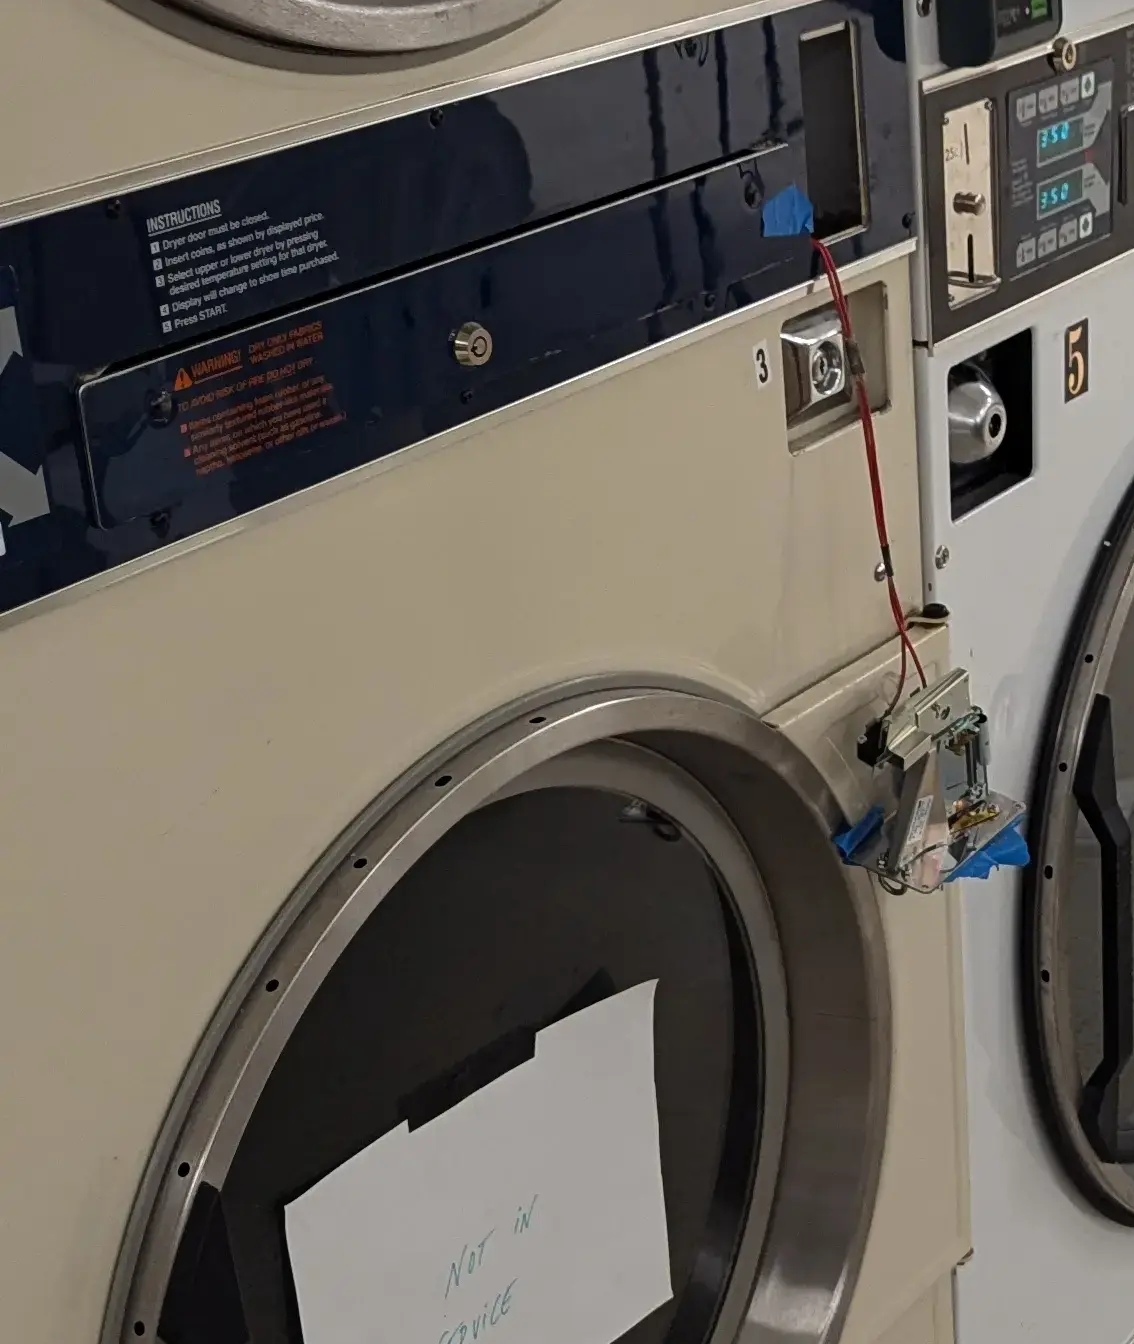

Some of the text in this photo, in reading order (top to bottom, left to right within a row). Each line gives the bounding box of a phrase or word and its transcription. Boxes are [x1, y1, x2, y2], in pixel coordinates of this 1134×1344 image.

[146, 199, 222, 234] INSTRUCTIONS
[162, 236, 186, 251] Dryer
[187, 229, 206, 243] door
[208, 223, 229, 237] must
[230, 219, 240, 231] be
[164, 252, 190, 268] Insert
[216, 242, 227, 251] as
[227, 233, 254, 248] shown
[255, 229, 266, 241] by
[266, 216, 303, 237] displayed
[167, 267, 194, 284] Select
[195, 262, 219, 279] upper
[219, 258, 229, 267] or
[230, 251, 252, 265] lower
[253, 242, 274, 258] dryer
[275, 239, 286, 251] by
[286, 230, 319, 250] pressing
[169, 278, 200, 296] desired
[201, 264, 250, 287] temperature
[250, 254, 278, 271] setting
[278, 250, 290, 261] for
[290, 244, 306, 256] that
[171, 294, 202, 314] Display
[203, 289, 217, 303] will
[218, 280, 248, 299] change
[249, 278, 258, 288] to
[258, 272, 280, 285] show
[280, 265, 298, 278] time
[174, 312, 198, 329] Press
[190, 349, 242, 378] WARNING!
[756, 348, 768, 384] 3
[1068, 325, 1085, 396] 5
[444, 1227, 497, 1299] NOT
